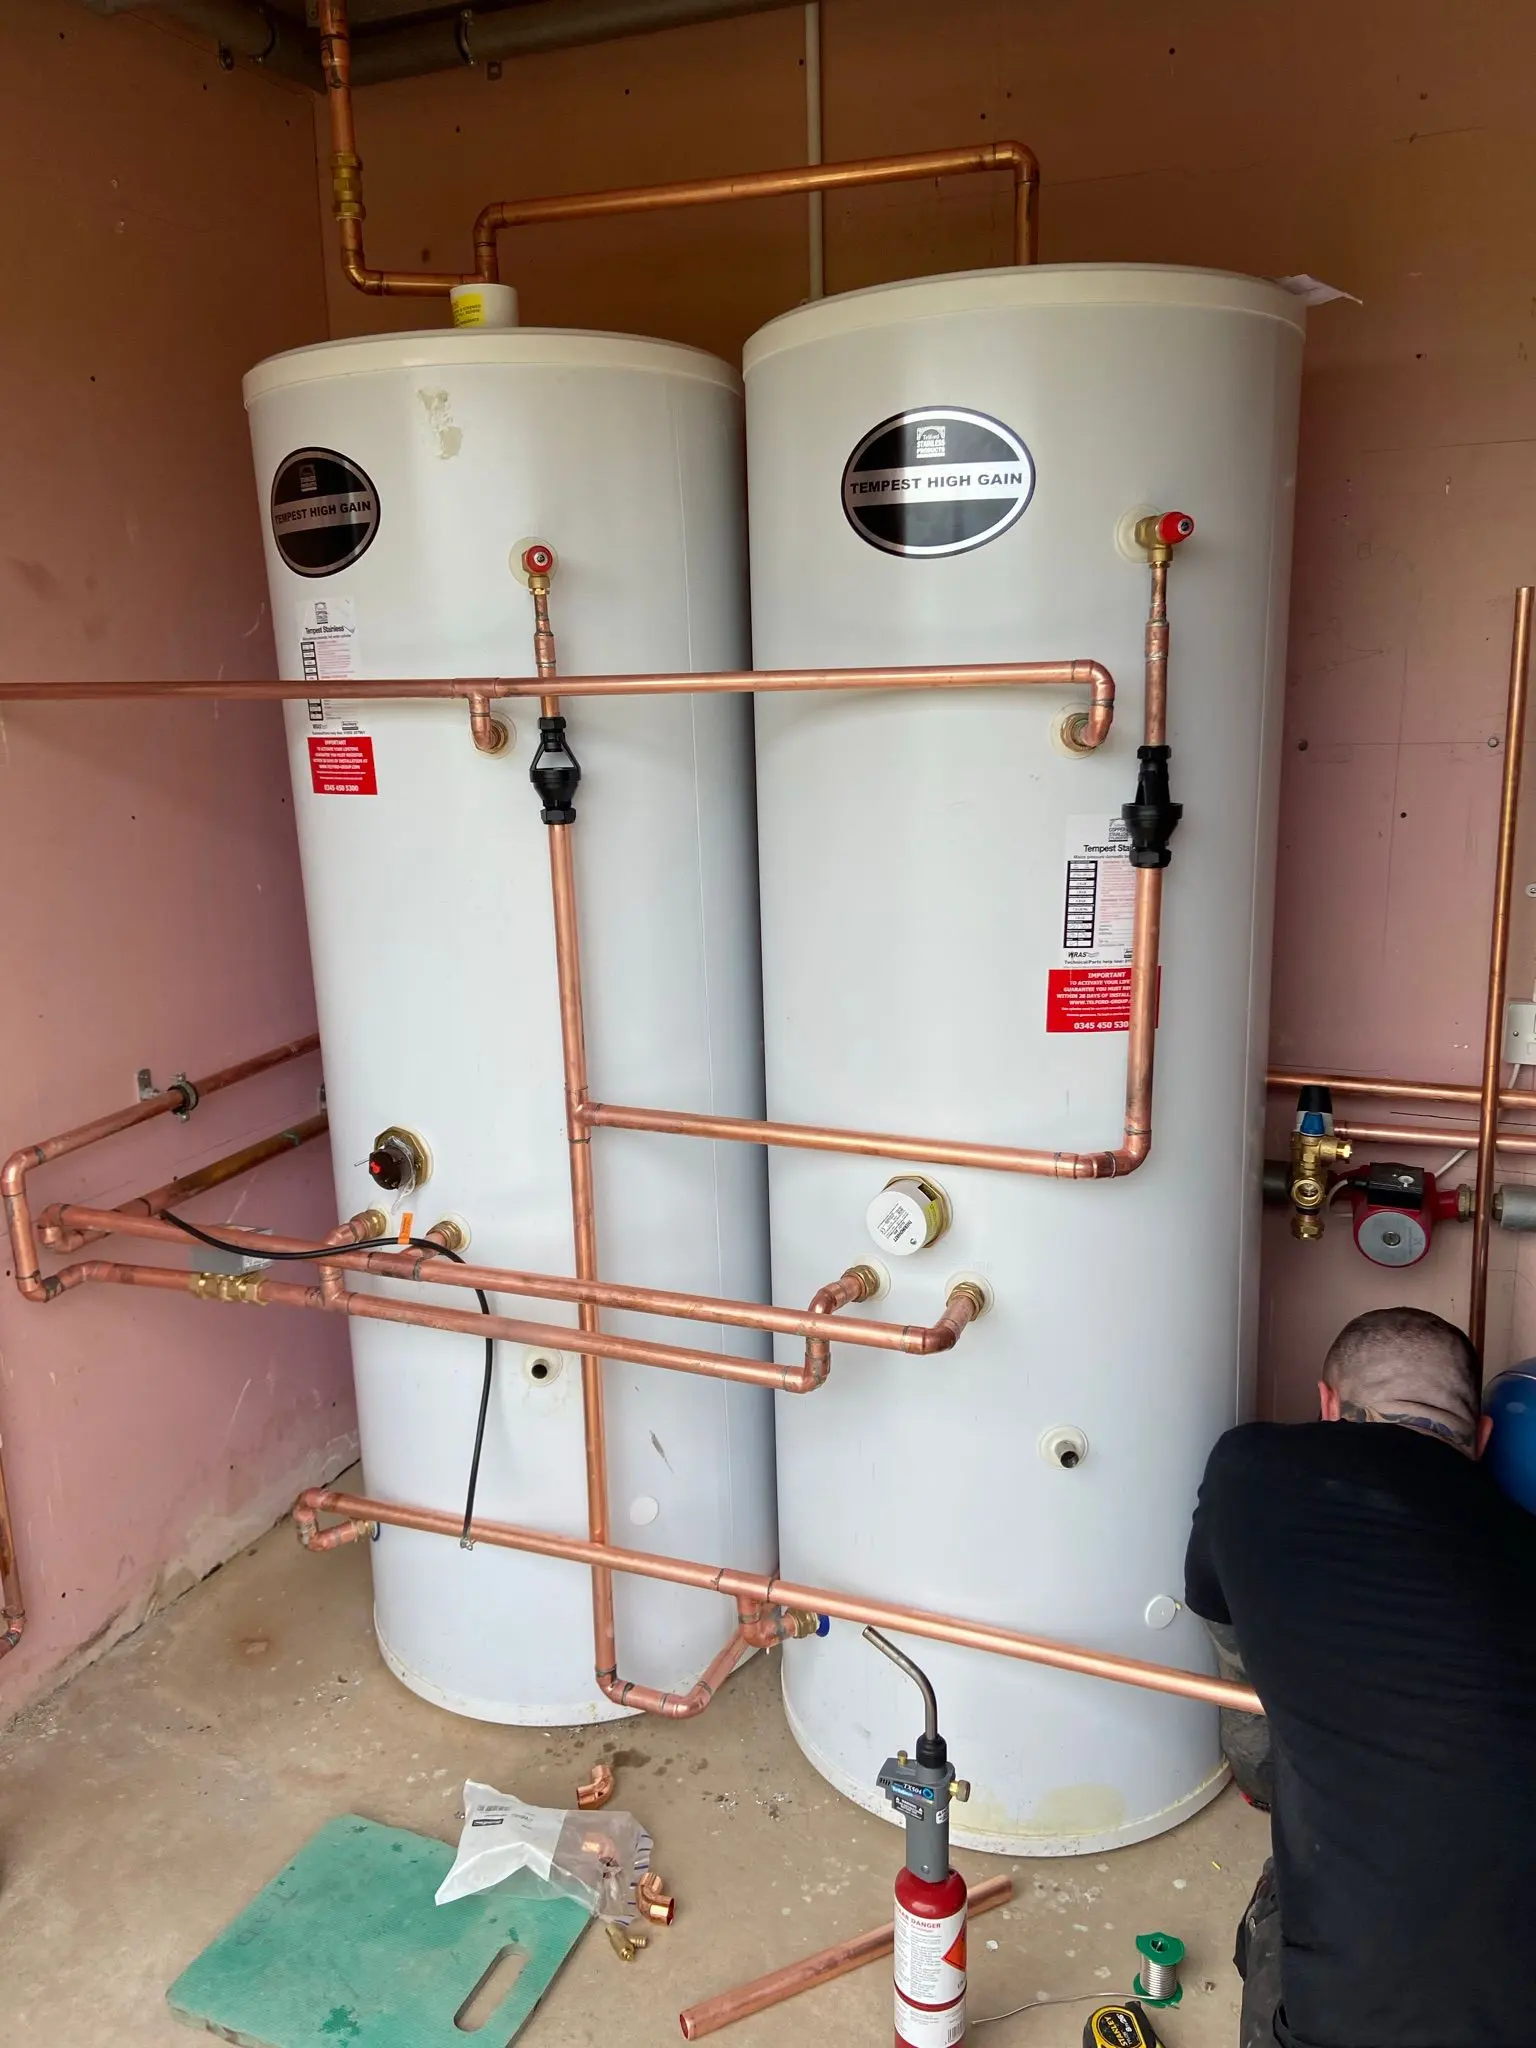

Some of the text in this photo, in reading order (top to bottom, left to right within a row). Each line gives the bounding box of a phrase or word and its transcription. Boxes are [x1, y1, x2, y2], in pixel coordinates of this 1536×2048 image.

[850, 472, 1023, 494] TEMPEST HIGH GAIN
[275, 501, 371, 525] TEMPEST HIGH GAIN
[1083, 844, 1116, 853] Tempest
[1088, 971, 1127, 979] IMPORTANT
[1074, 1022, 1095, 1030] 0345
[1096, 1021, 1113, 1029] 450
[903, 1783, 923, 1795] TX504
[911, 1919, 942, 1929] DANGER
[1104, 2016, 1129, 2047] STANLEY
